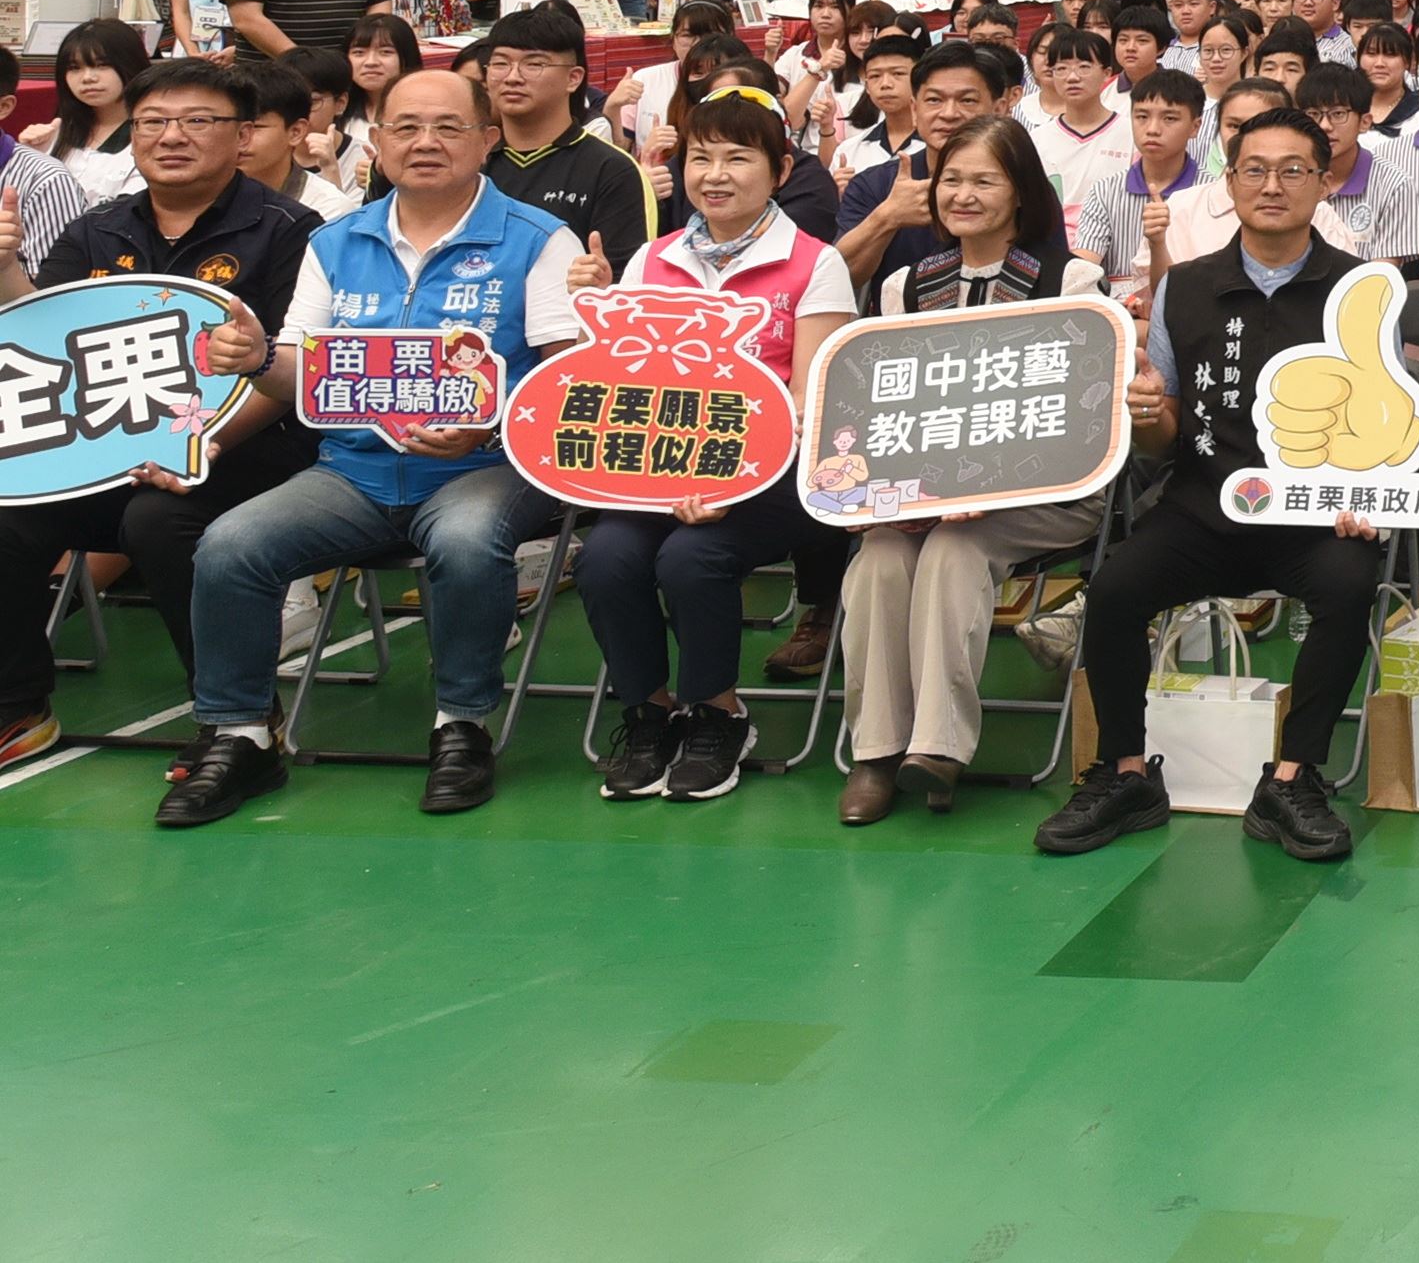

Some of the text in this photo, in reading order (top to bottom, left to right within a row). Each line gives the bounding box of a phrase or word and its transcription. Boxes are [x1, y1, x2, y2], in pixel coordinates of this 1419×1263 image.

[771, 291, 790, 341] 議員
[326, 337, 434, 376] 苗栗
[871, 339, 1073, 403] 國中技藝
[1222, 316, 1245, 408] 特別助理
[313, 378, 478, 416] 值得驕傲
[560, 383, 748, 435] 苗栗願景
[865, 392, 1068, 458] 教育課程
[553, 429, 745, 479] 前程似錦
